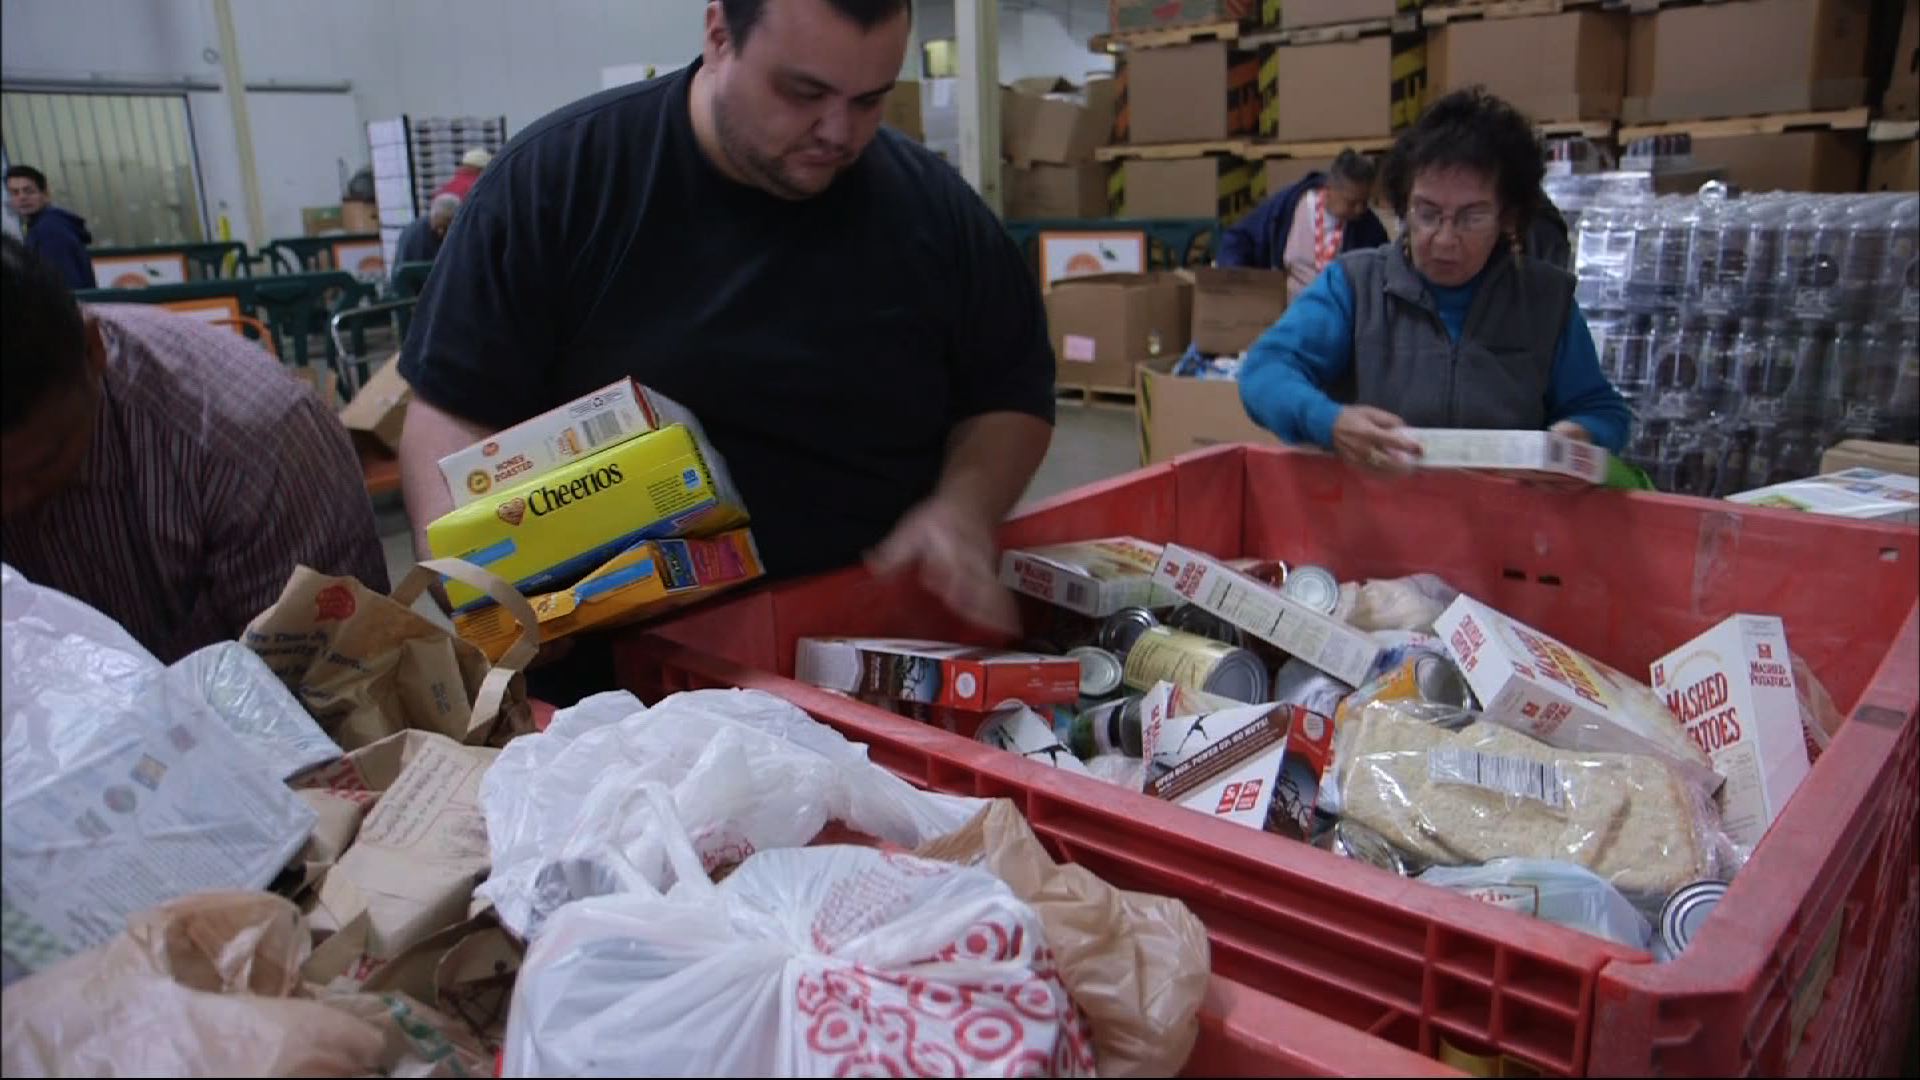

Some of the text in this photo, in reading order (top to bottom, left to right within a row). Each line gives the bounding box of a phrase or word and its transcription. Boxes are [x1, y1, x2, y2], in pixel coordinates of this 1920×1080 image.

[494, 460, 534, 482] ROASTED
[495, 454, 525, 472] HONEY
[528, 463, 623, 517] Cheerios
[1750, 661, 1787, 675] MASHED
[1666, 672, 1728, 724] MASHED
[1243, 718, 1270, 739] NUTS!
[1687, 707, 1741, 753] ATOES
